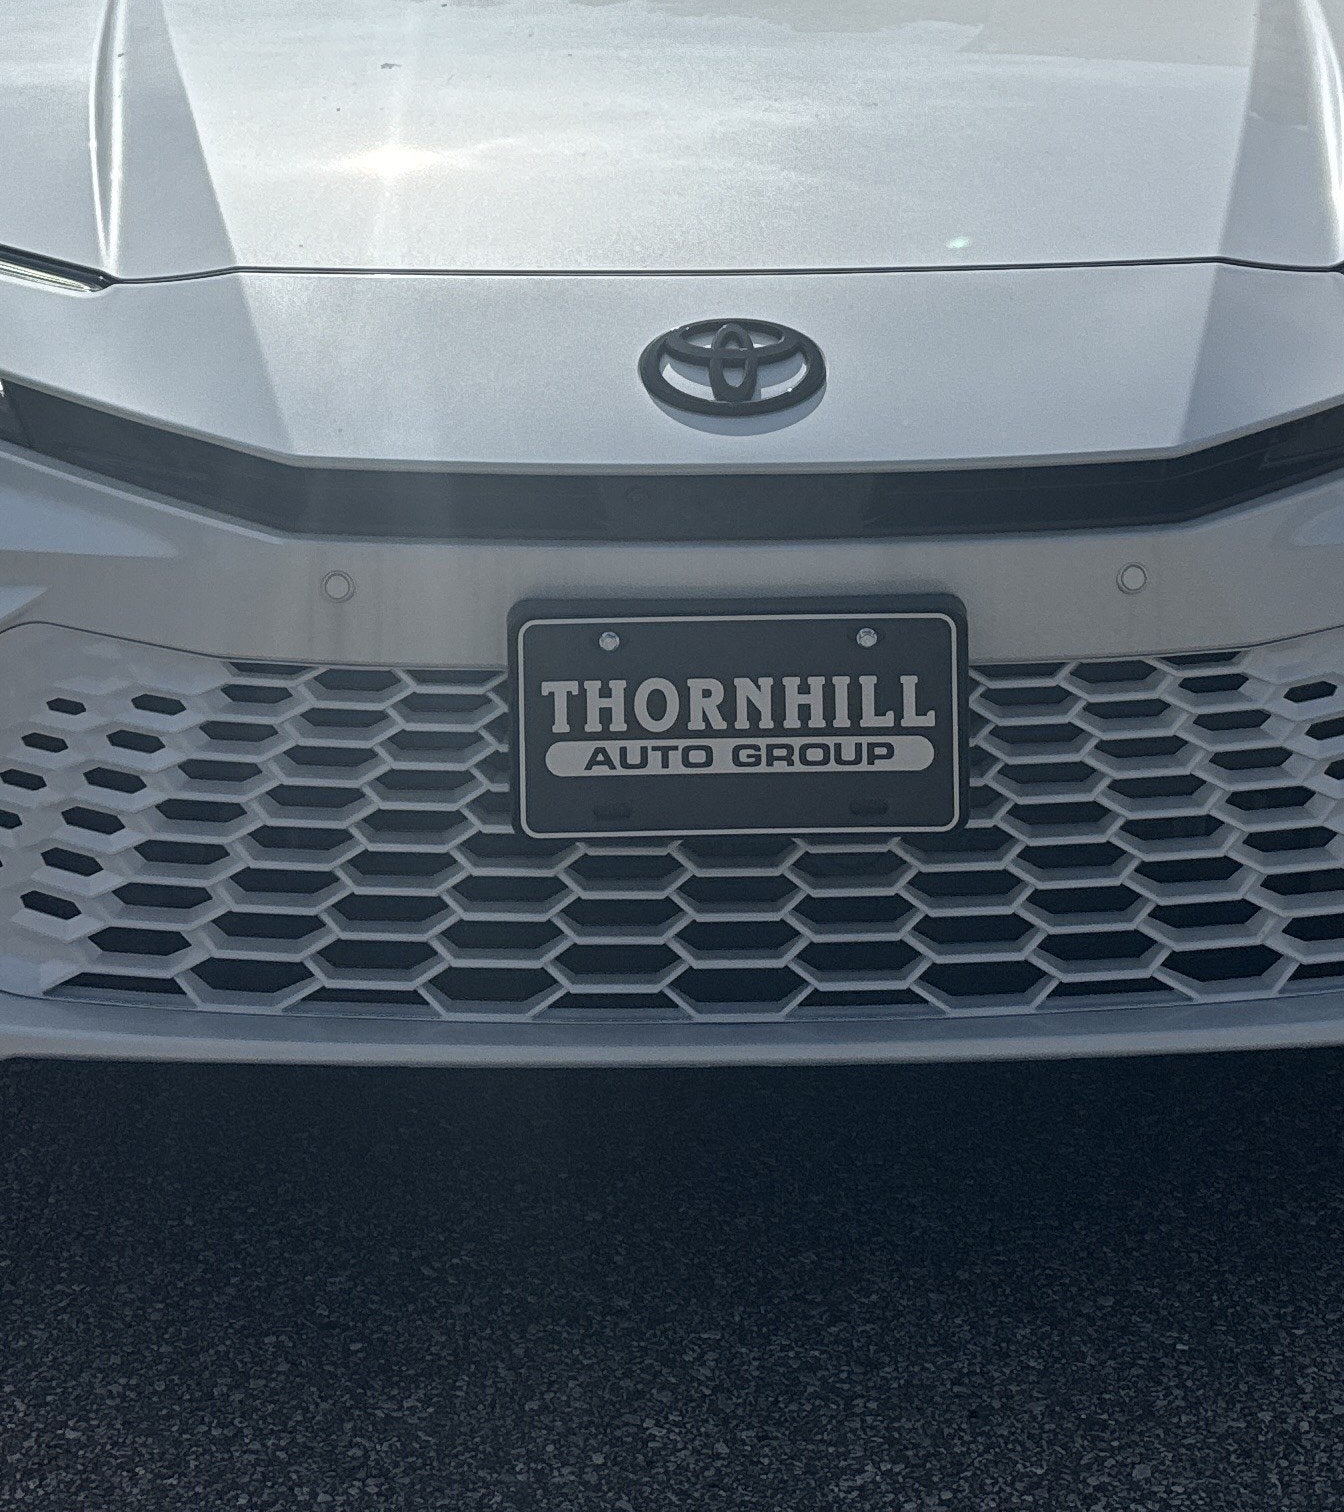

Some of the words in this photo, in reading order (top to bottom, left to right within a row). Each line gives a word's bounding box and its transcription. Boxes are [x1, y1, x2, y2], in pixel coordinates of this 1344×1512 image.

[541, 676, 936, 733] THORNHILL
[584, 744, 715, 771] AUTO
[731, 741, 896, 768] GROUP
